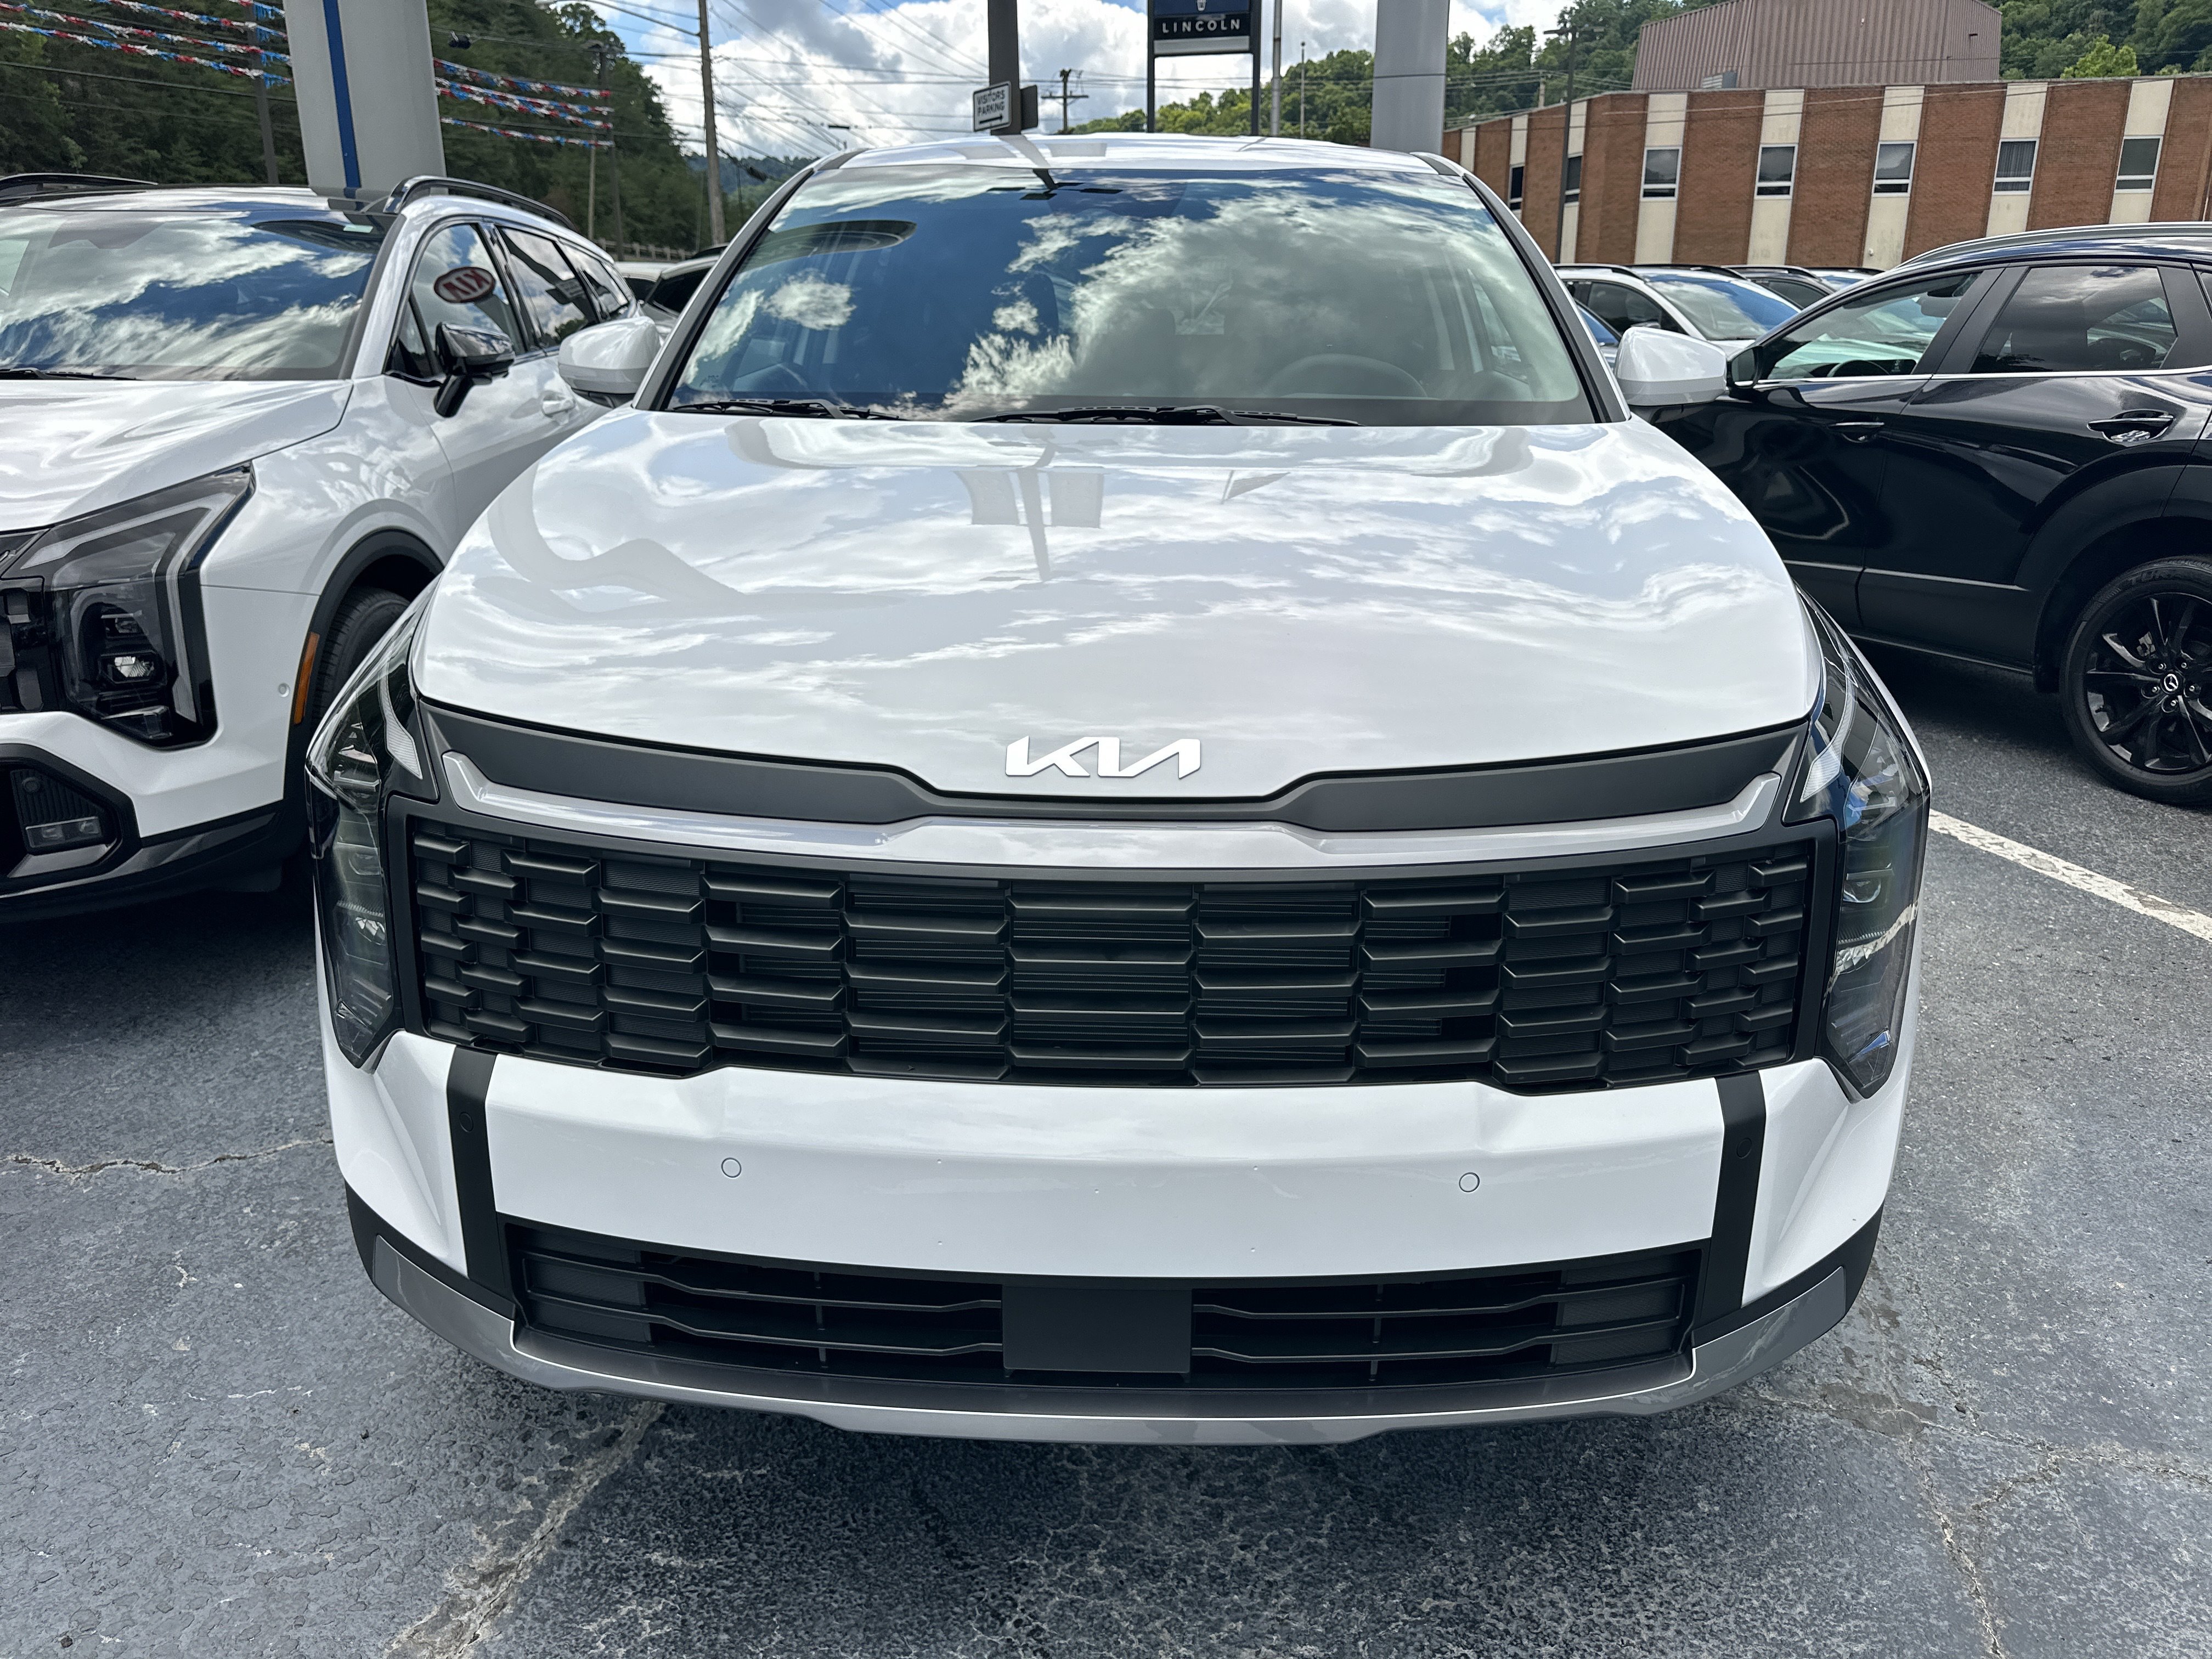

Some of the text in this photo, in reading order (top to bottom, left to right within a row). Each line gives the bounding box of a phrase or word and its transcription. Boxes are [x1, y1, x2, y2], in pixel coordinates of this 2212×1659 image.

[1162, 19, 1240, 33] LINCOLN
[977, 89, 1006, 106] VISITORS
[977, 101, 1005, 116] PARKING
[1005, 735, 1201, 780] KIA
